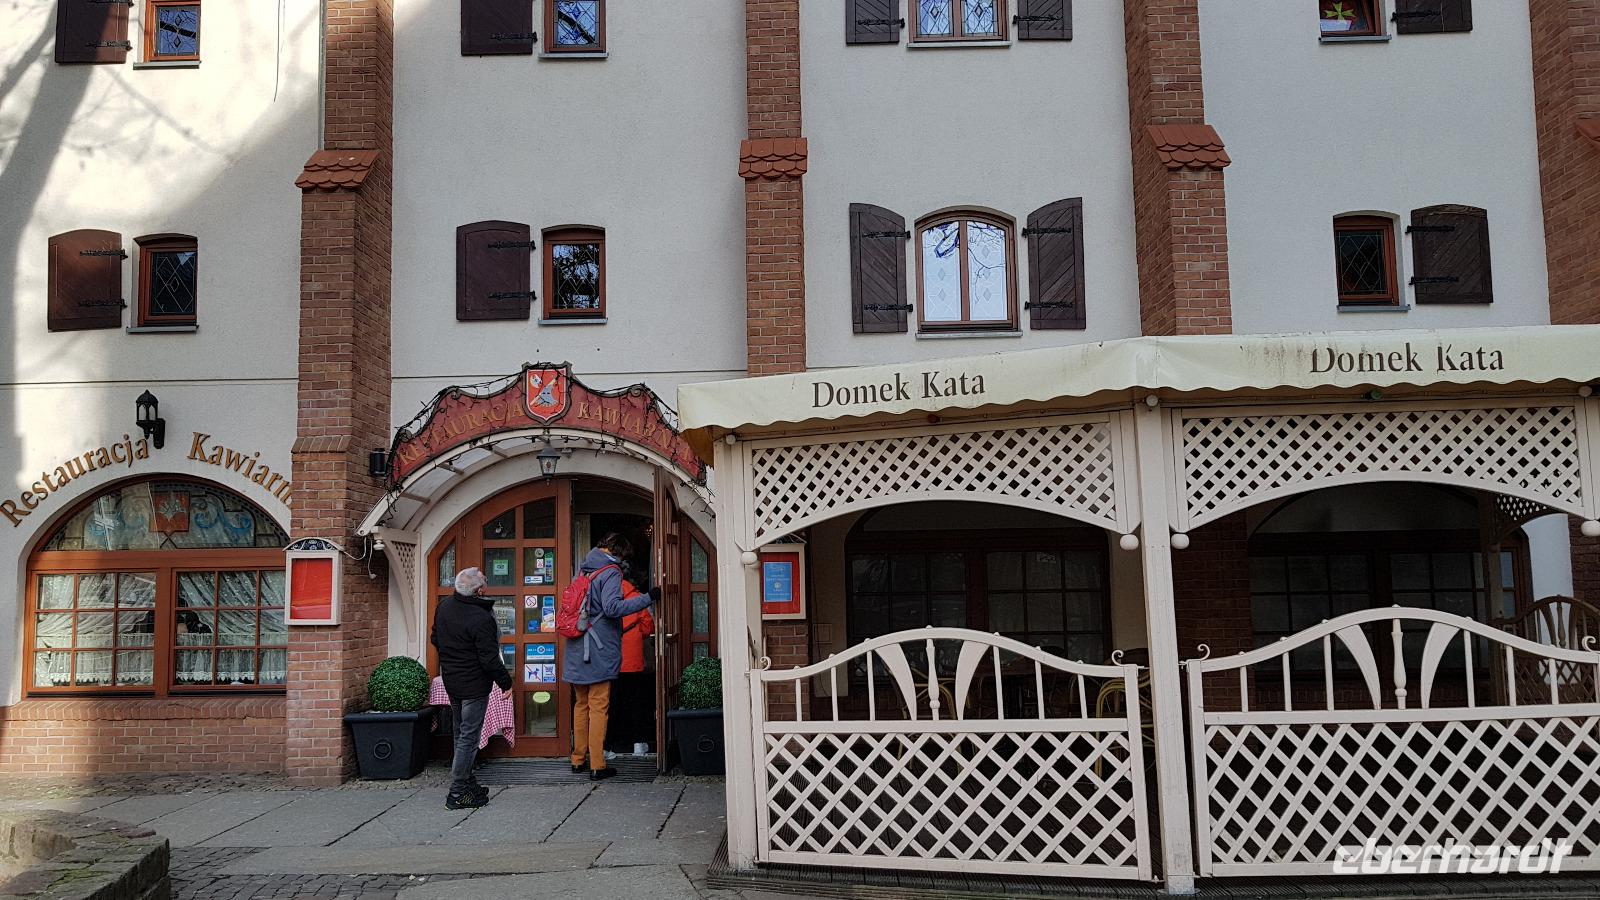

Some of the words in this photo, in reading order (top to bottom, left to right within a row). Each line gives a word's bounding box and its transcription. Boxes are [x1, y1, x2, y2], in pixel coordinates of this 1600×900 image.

[1310, 342, 1423, 373] Domek
[1433, 343, 1505, 373] Kata
[812, 372, 911, 408] Domek
[921, 371, 986, 399] Kata
[577, 401, 692, 463] KAWIARNA
[0, 434, 149, 527] Restauracja
[187, 431, 292, 510] Kawiarn
